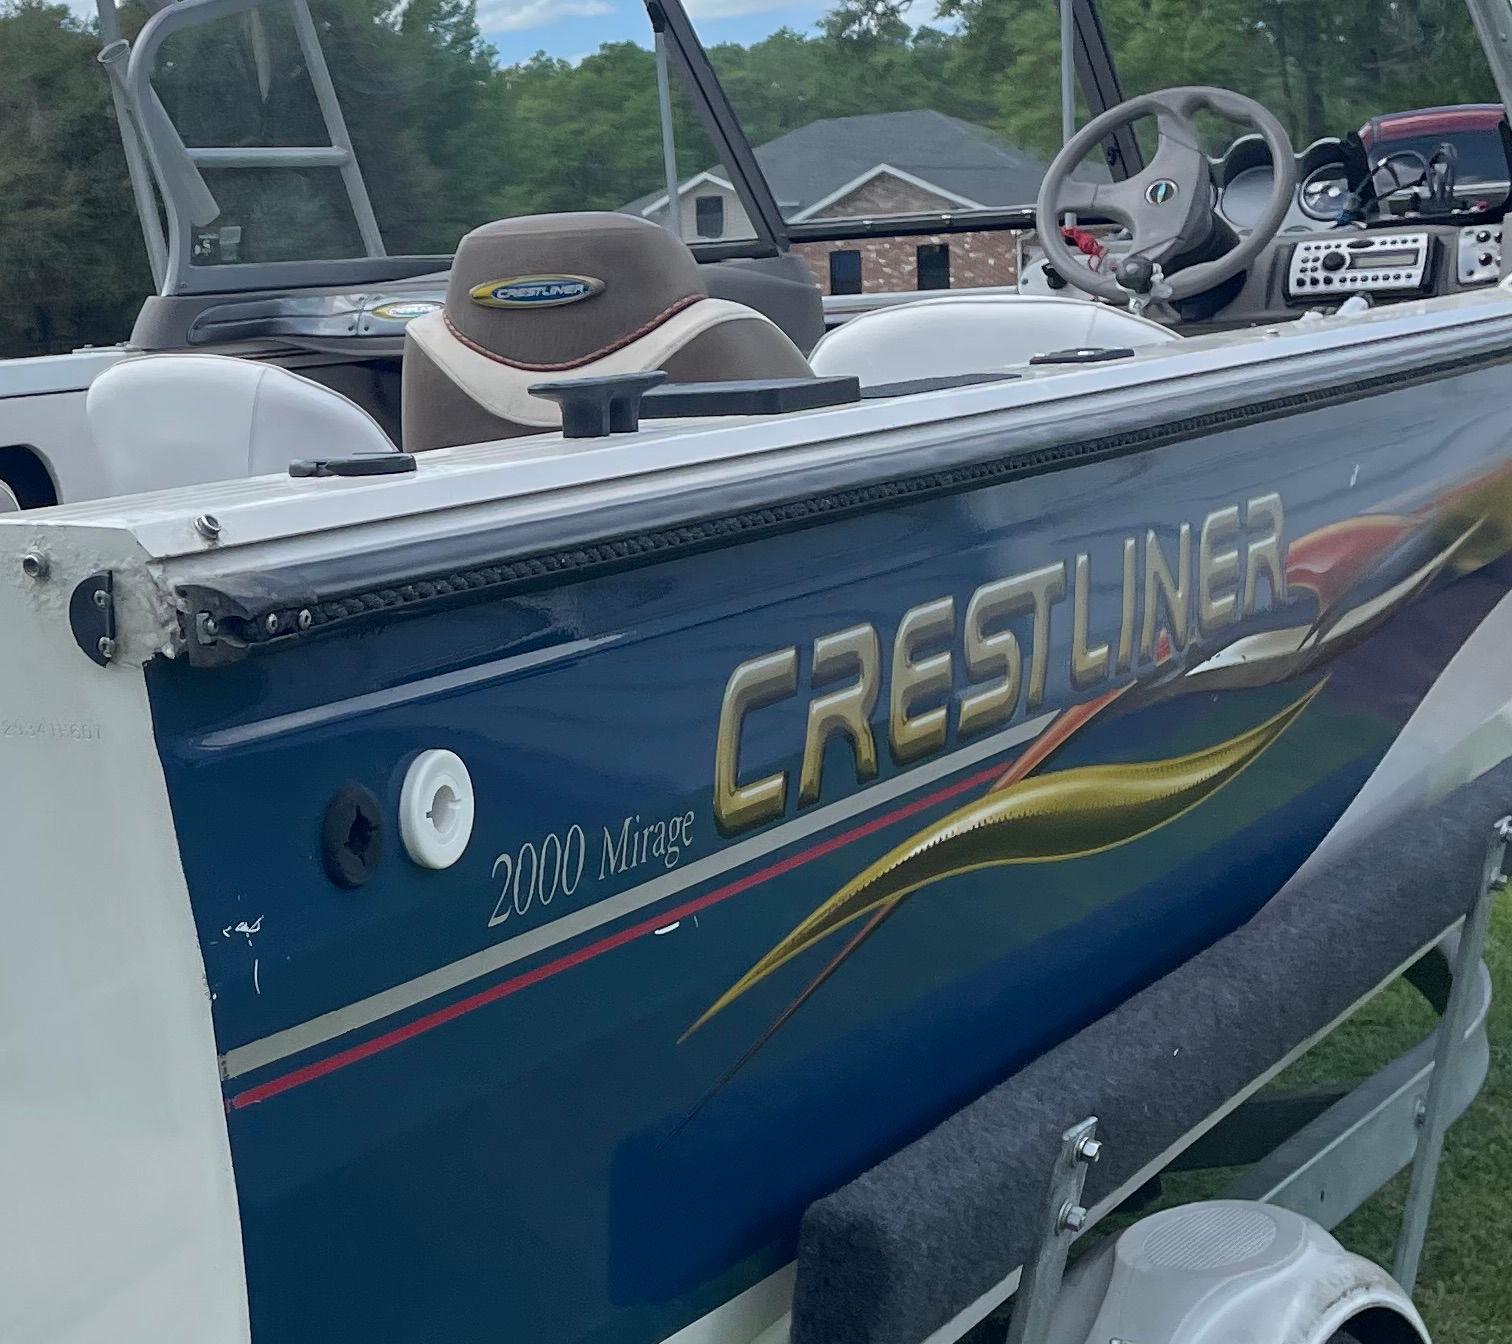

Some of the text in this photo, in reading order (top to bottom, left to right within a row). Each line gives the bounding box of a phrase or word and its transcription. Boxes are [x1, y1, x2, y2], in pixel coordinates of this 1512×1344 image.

[496, 283, 585, 299] CRESTLINER
[713, 491, 1285, 838] CRESTLINER
[488, 810, 695, 928] 2000 Mirage
